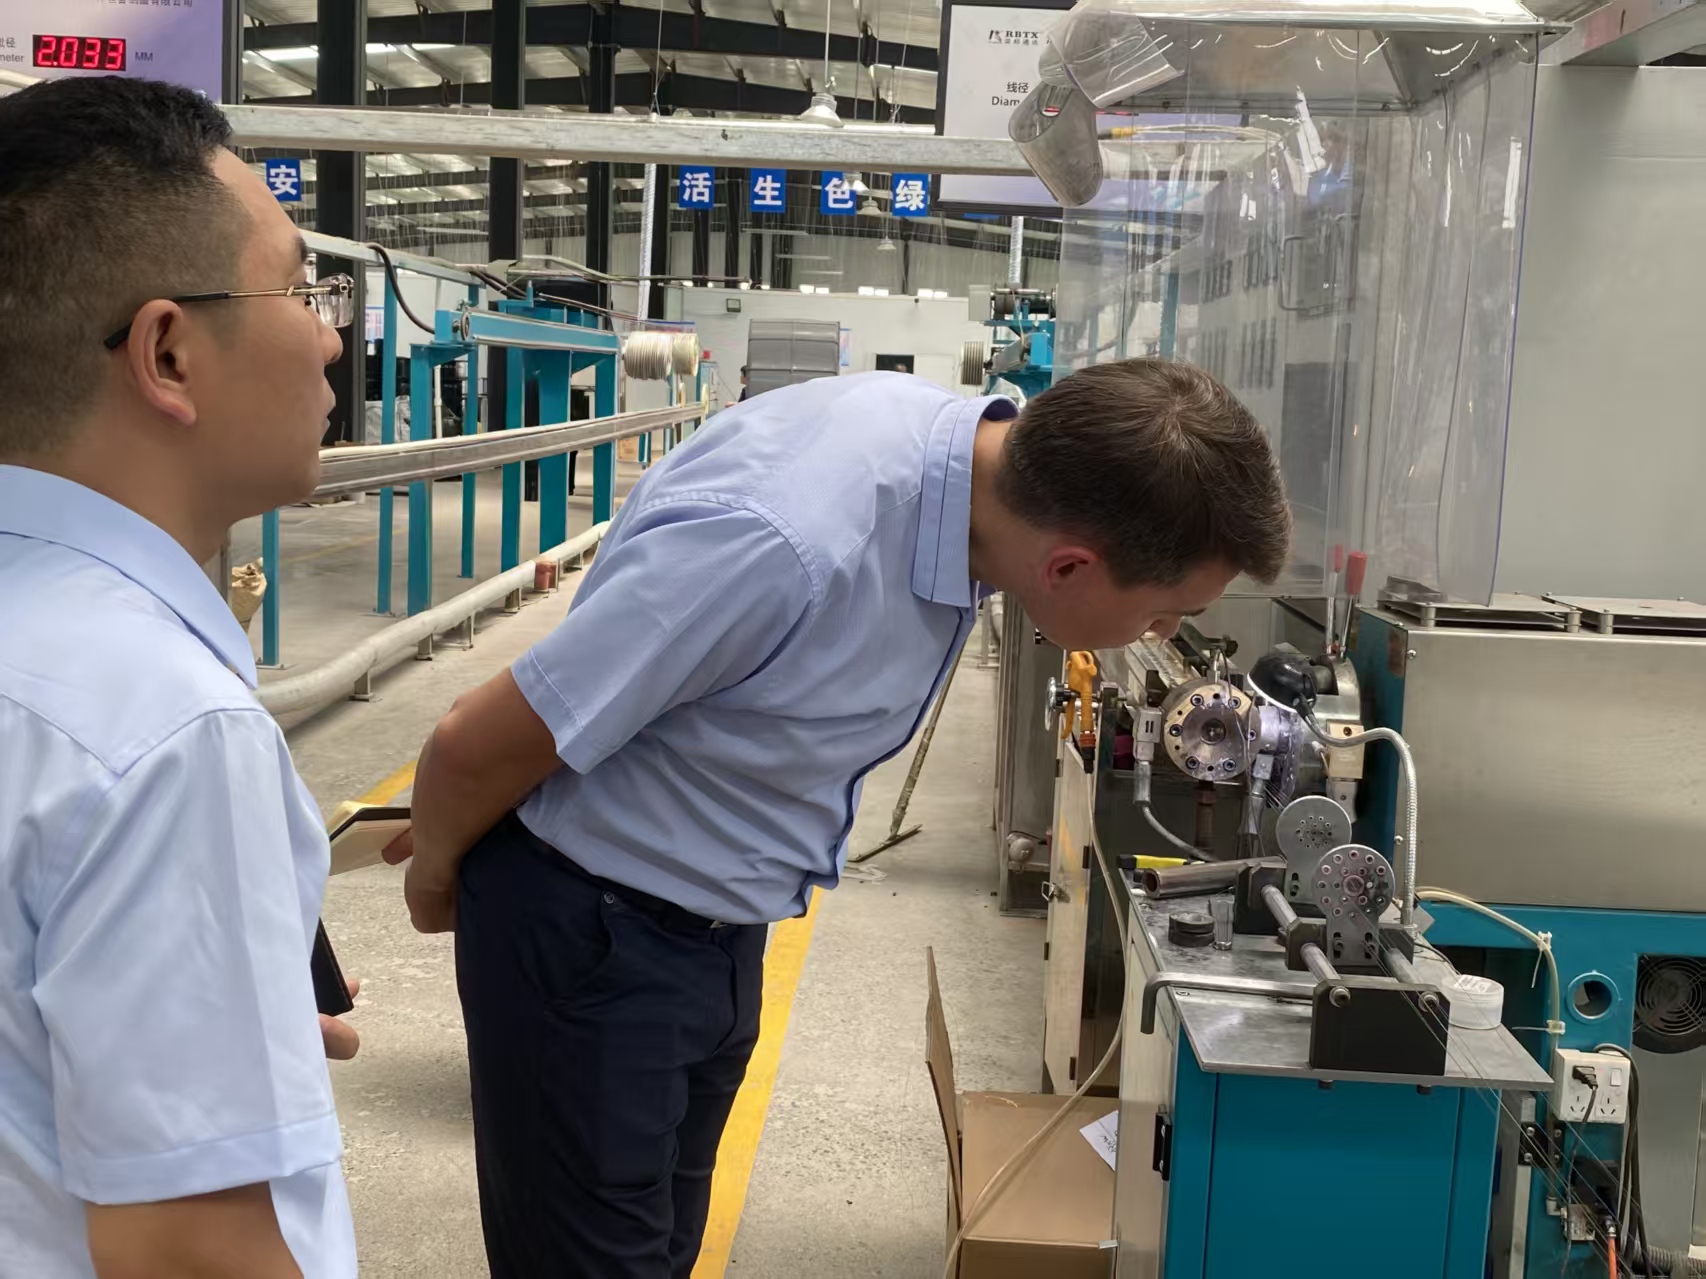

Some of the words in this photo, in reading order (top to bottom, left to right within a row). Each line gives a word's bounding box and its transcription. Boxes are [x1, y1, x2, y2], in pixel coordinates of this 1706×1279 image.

[1005, 30, 1040, 39] RBTX
[37, 36, 124, 70] 2.033
[135, 52, 154, 62] MM
[1006, 81, 1029, 94] 线径
[268, 164, 299, 196] 安
